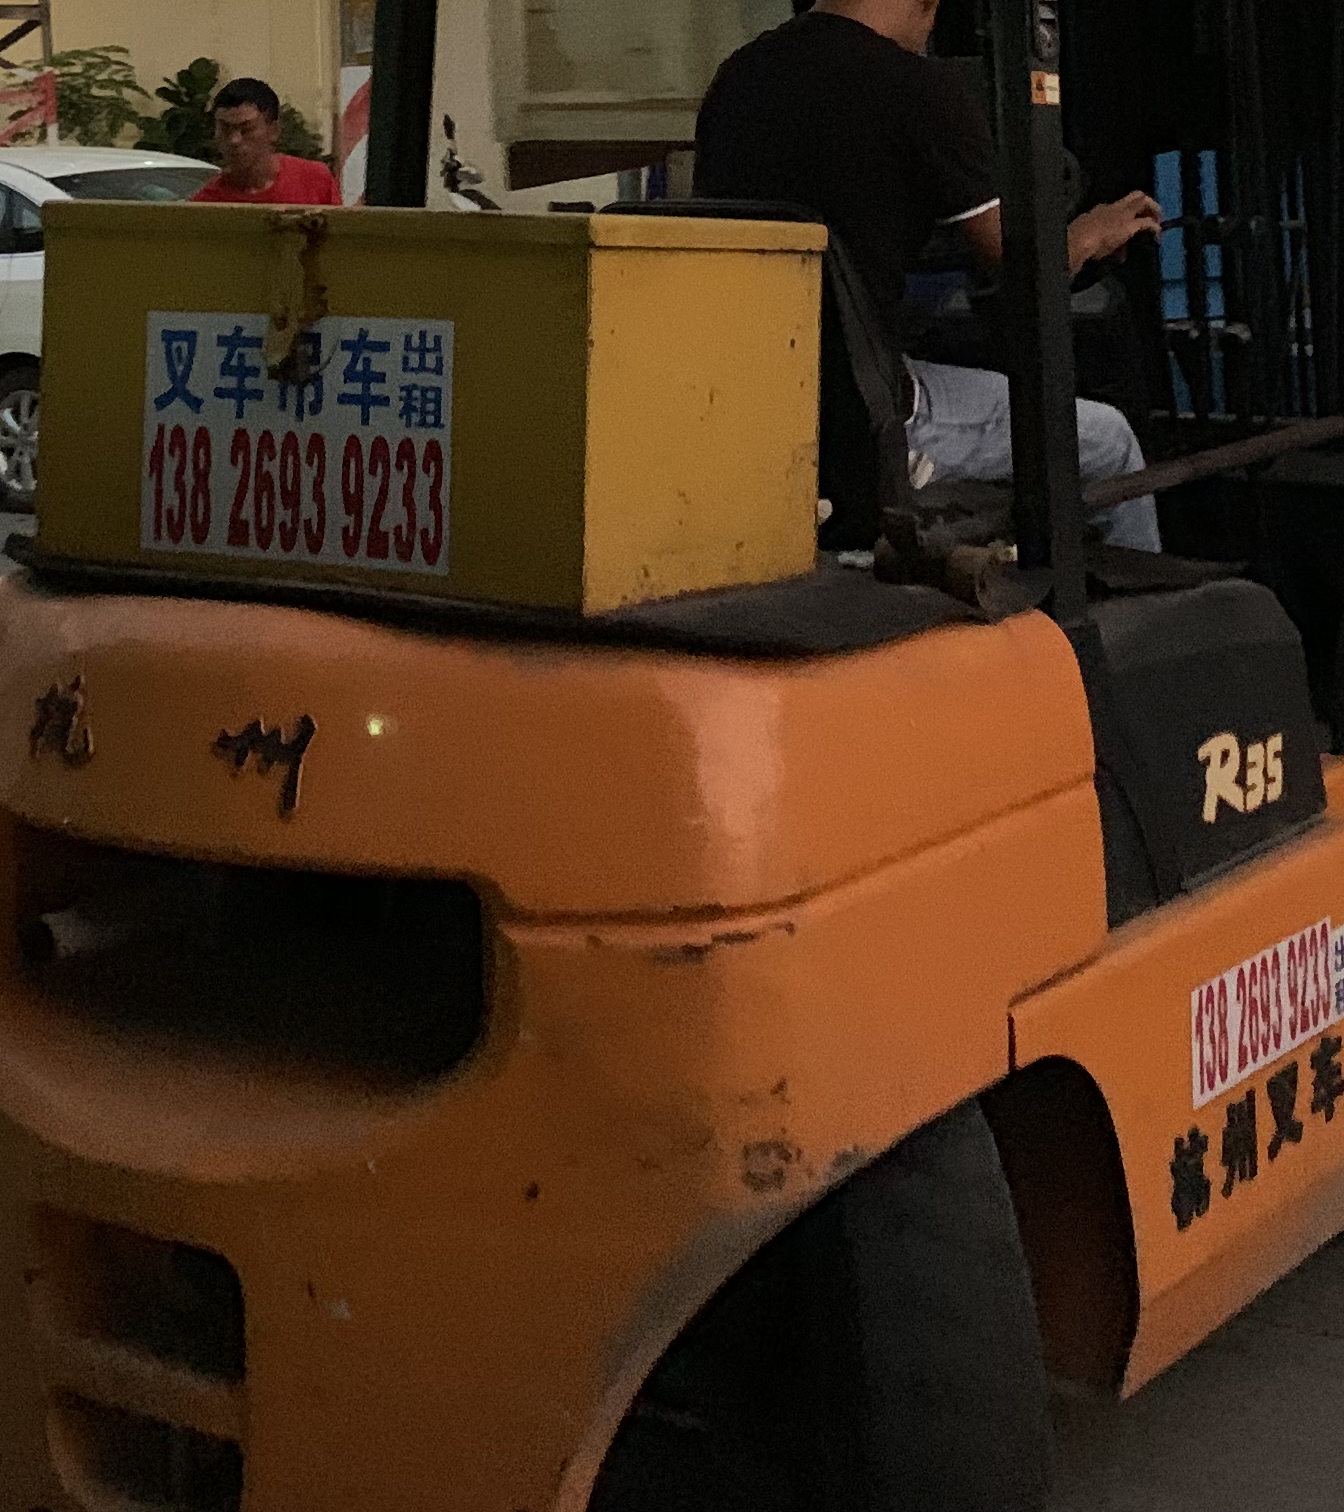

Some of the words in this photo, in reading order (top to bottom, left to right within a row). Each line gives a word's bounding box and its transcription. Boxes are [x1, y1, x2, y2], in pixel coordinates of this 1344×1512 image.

[398, 329, 446, 430] 出租
[148, 424, 214, 546] 138
[227, 428, 328, 555] 2693
[341, 433, 446, 568] 9233
[1197, 731, 1284, 824] R35
[1194, 976, 1230, 1096] 138
[1235, 947, 1283, 1073] 2693
[1286, 922, 1332, 1041] 9233
